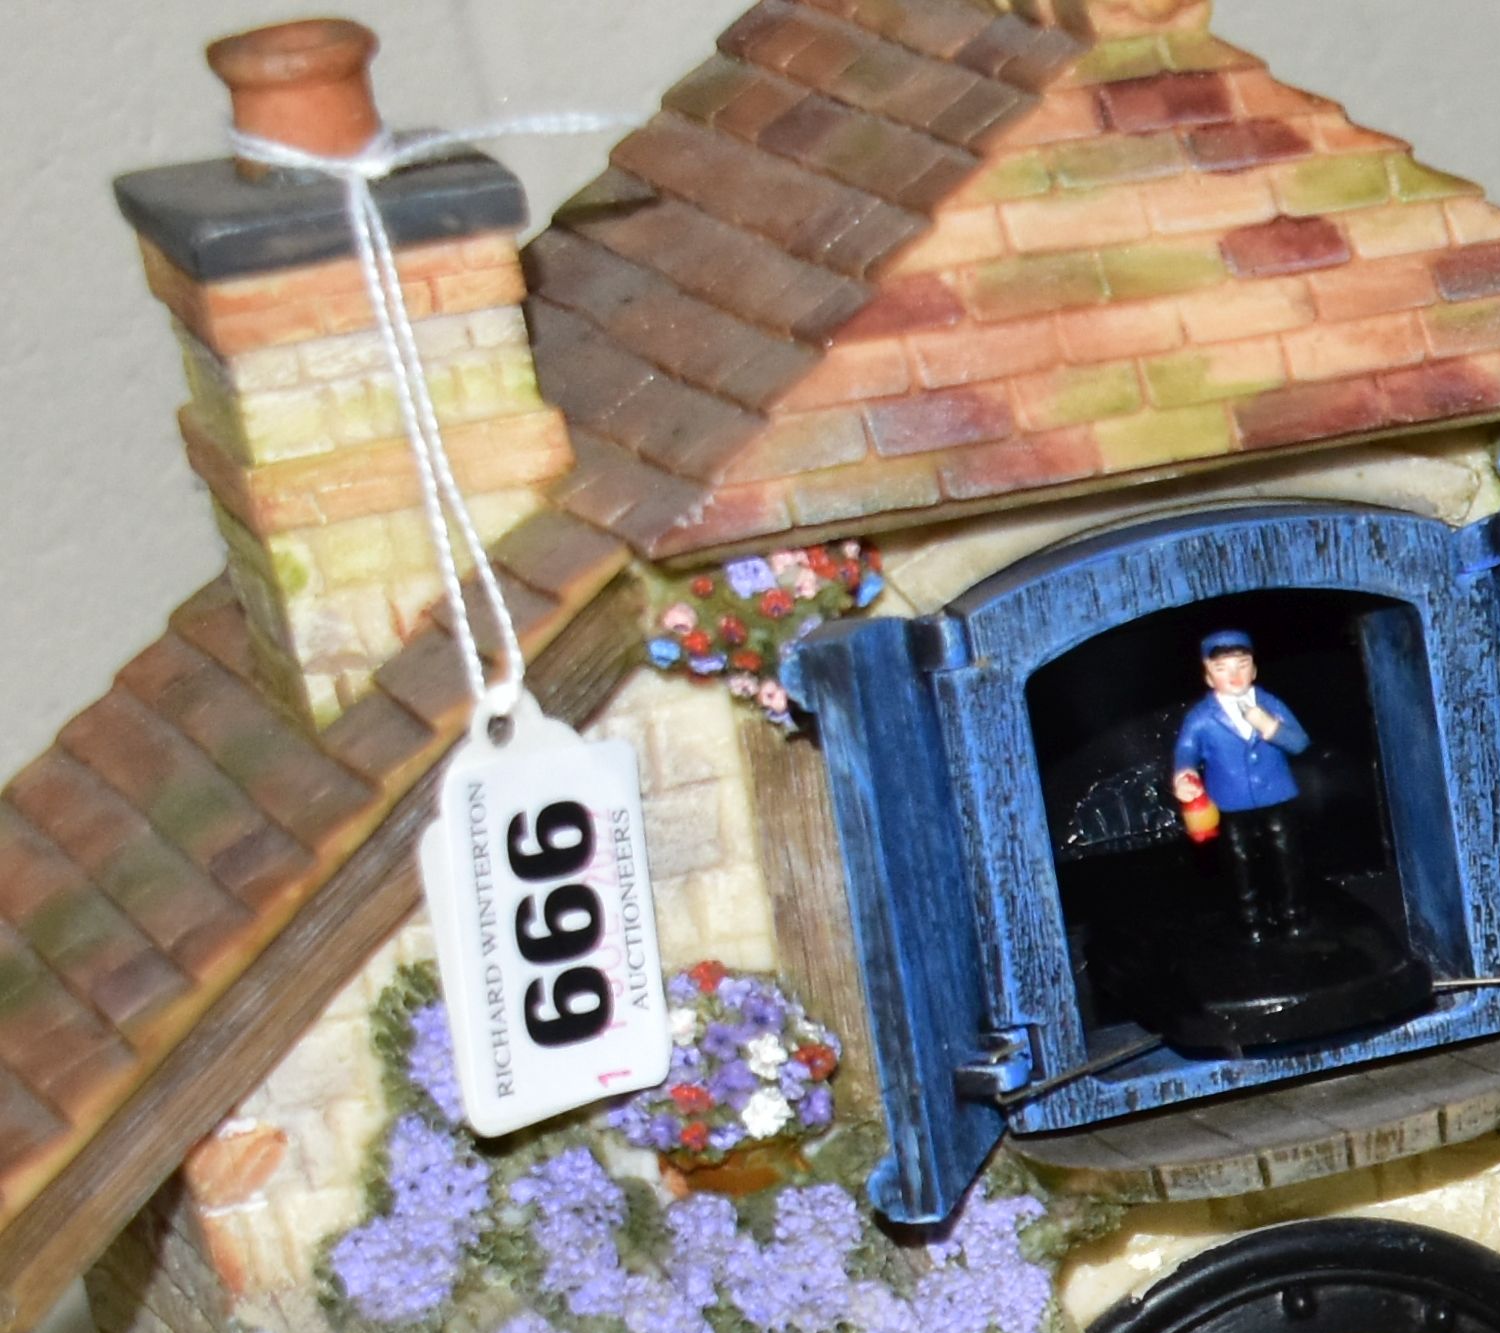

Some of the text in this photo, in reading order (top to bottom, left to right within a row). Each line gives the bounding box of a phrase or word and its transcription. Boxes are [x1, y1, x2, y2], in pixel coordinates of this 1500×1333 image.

[468, 781, 513, 1098] RICHARD WINTERTON
[507, 801, 616, 1047] 666
[617, 807, 651, 1011] AUCTIONEERS
